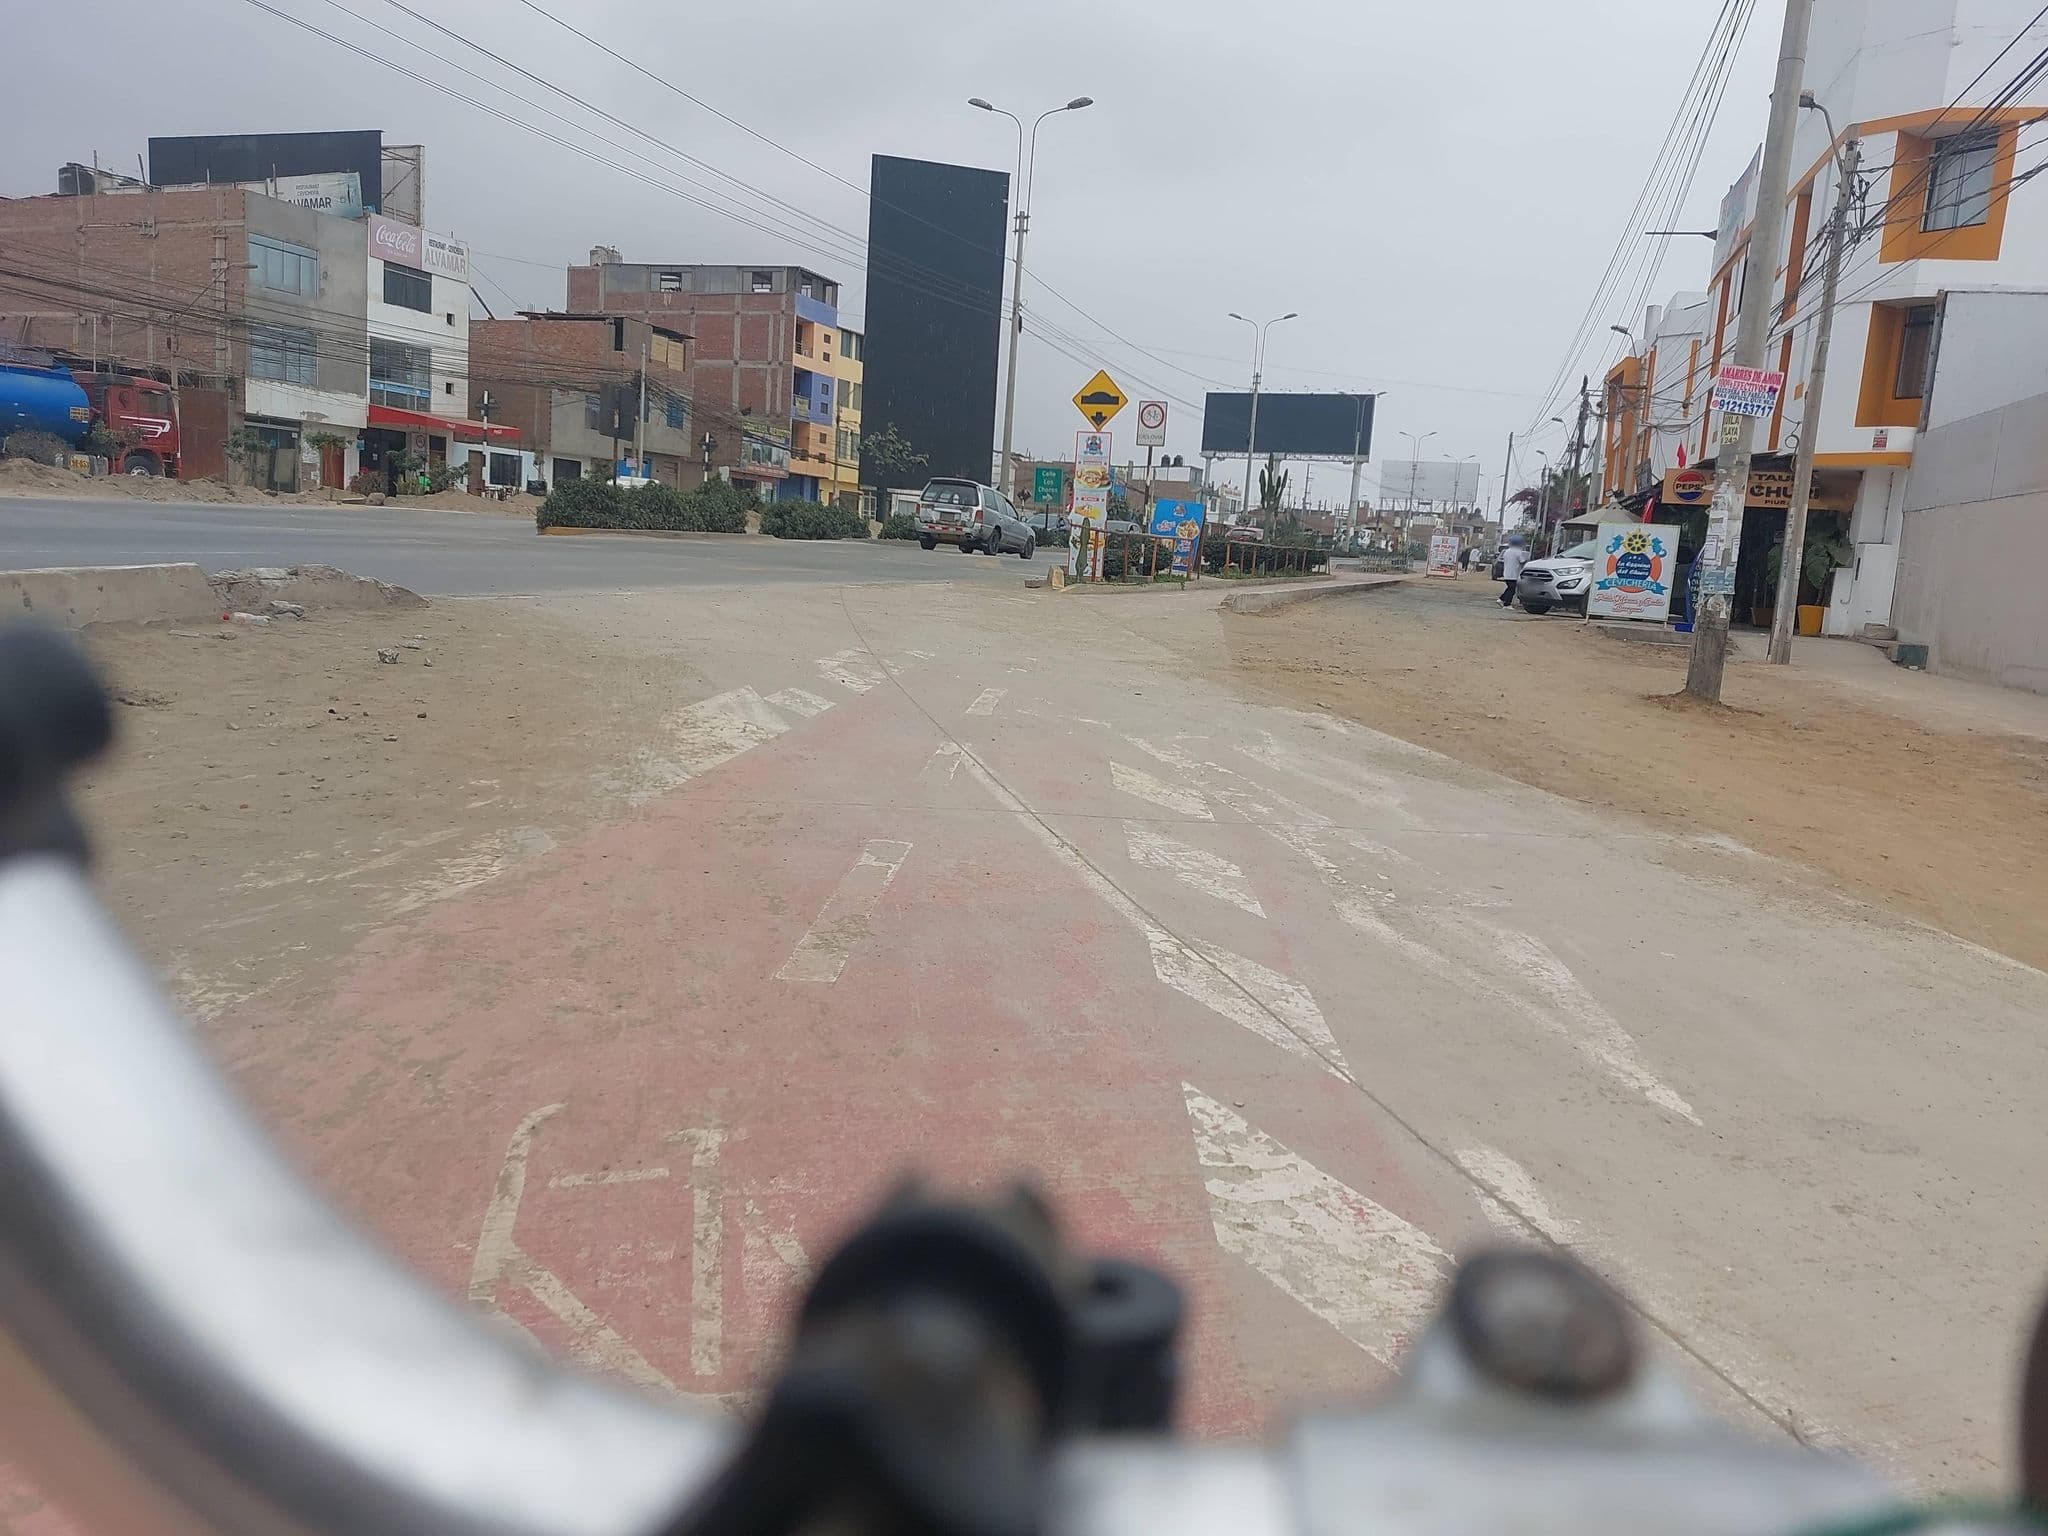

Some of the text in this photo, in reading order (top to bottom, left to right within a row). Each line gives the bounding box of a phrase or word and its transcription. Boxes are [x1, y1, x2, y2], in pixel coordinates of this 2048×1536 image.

[424, 248, 466, 274] ALVAMAR
[1720, 366, 1782, 387] AMARRES DE AMOR
[1732, 380, 1767, 393] EFECTIVOS
[1718, 399, 1774, 417] 912153717
[1605, 578, 1658, 590] CEVICHERIA
